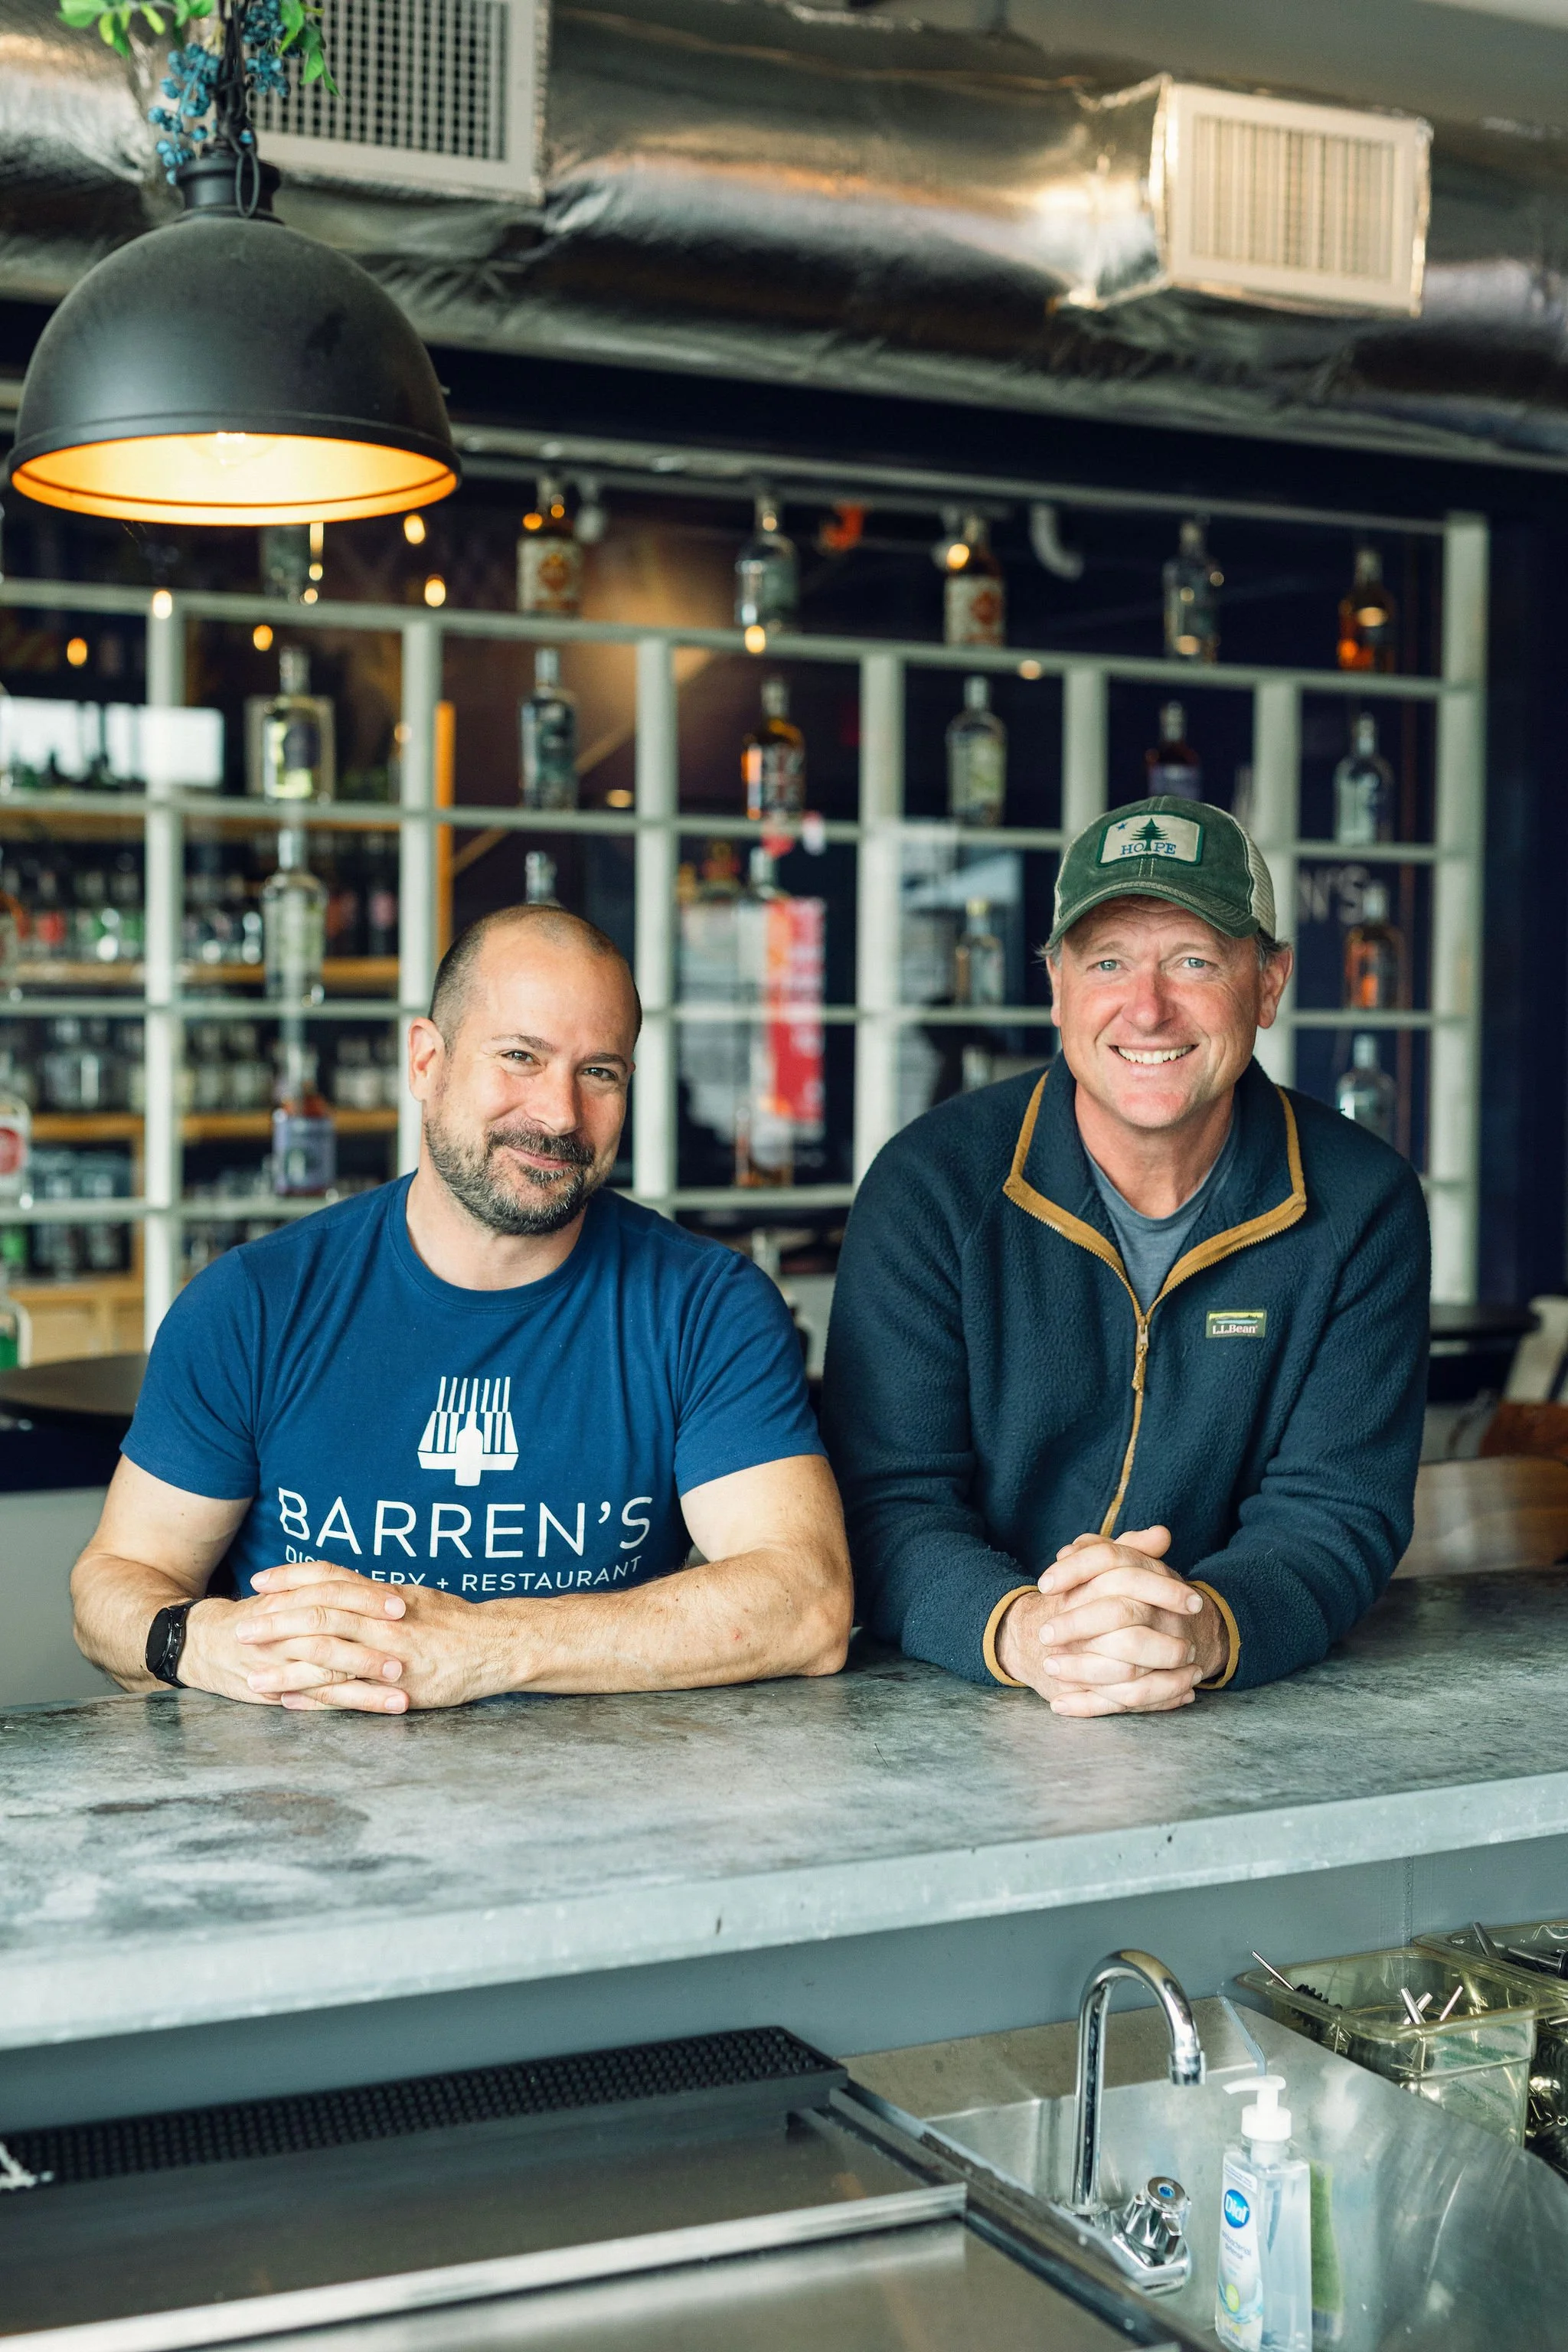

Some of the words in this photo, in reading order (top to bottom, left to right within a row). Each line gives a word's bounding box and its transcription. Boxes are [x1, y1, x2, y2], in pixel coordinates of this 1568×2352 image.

[1120, 842, 1177, 856] HOPE
[278, 1487, 653, 1559] BARREN'S
[462, 1555, 642, 1592] RESTAURANT
[1225, 2193, 1249, 2224] Dial
